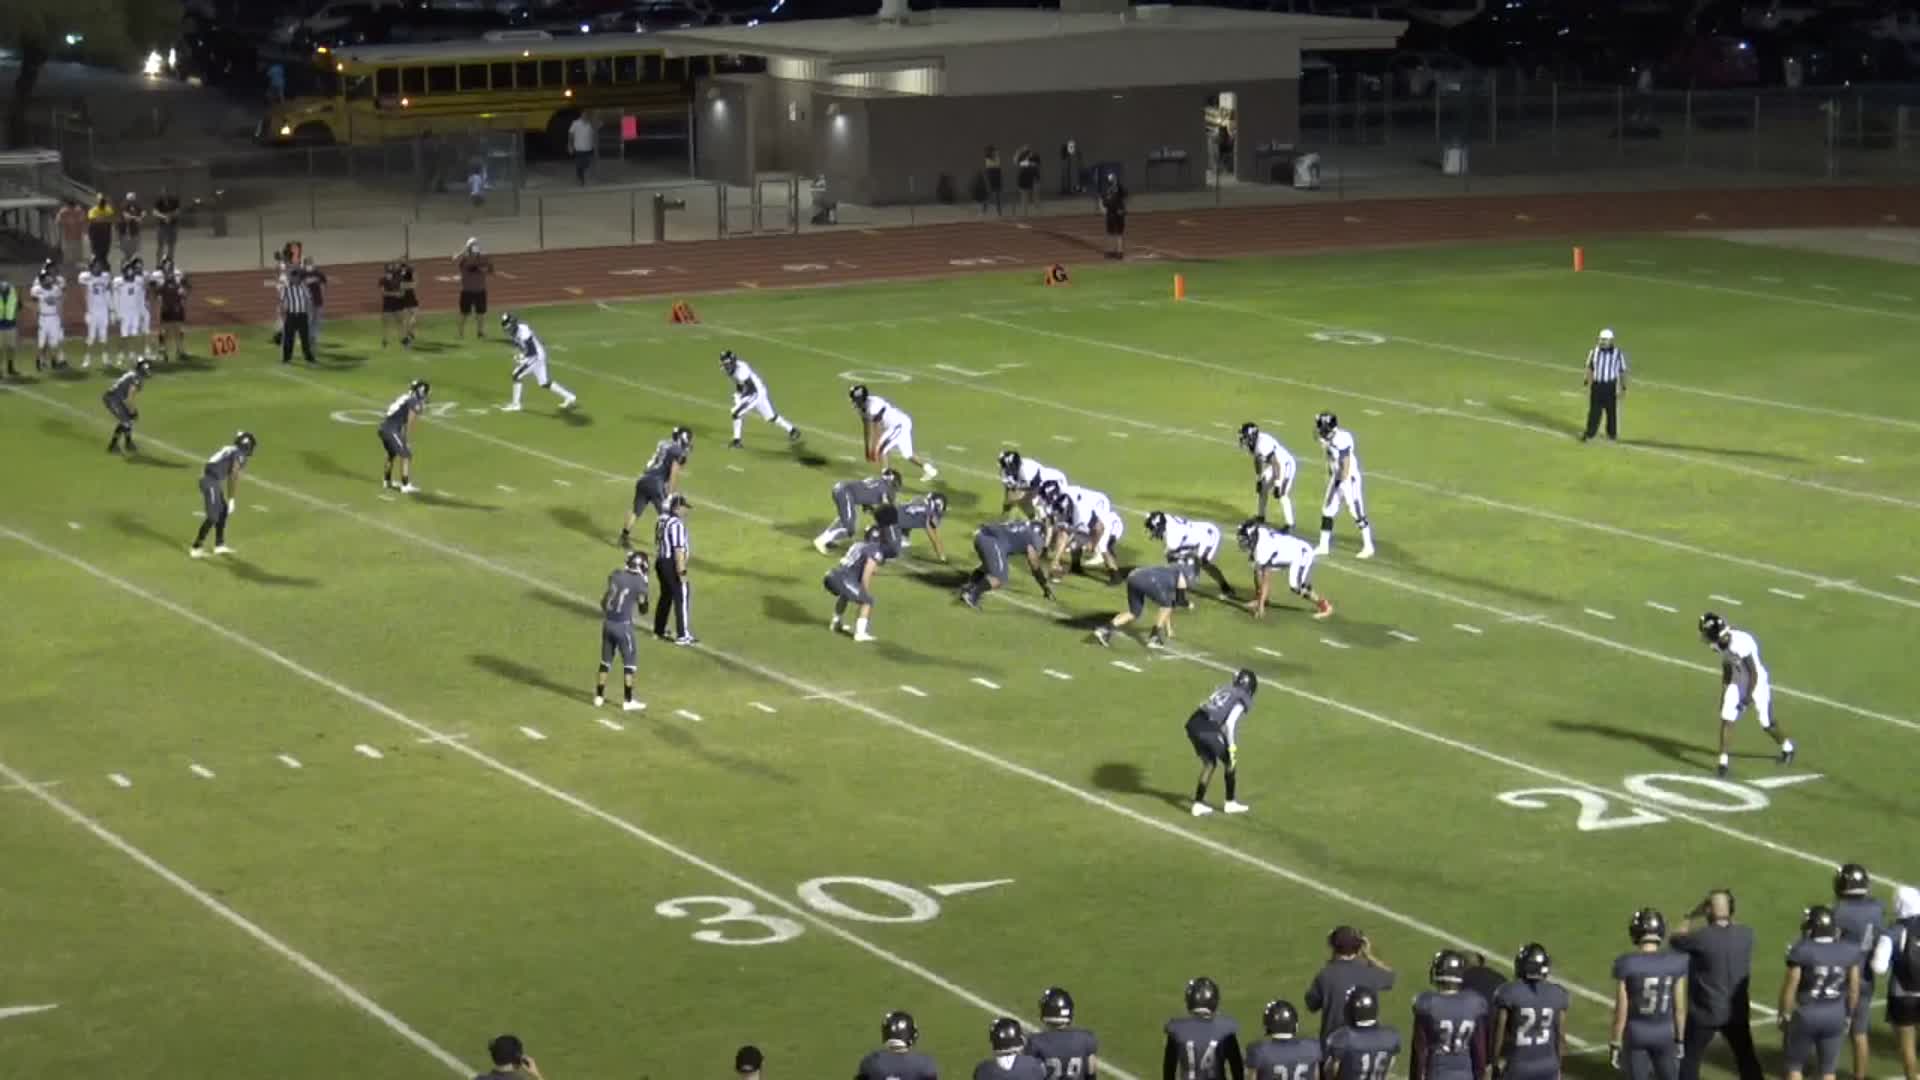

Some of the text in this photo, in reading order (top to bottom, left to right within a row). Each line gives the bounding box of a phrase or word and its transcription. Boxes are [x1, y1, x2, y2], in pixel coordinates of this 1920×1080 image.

[1496, 773, 1771, 831] 20
[654, 875, 941, 945] 30
[1640, 976, 1673, 1014] 51
[1516, 1007, 1554, 1047] 23
[1185, 1040, 1218, 1080] 14
